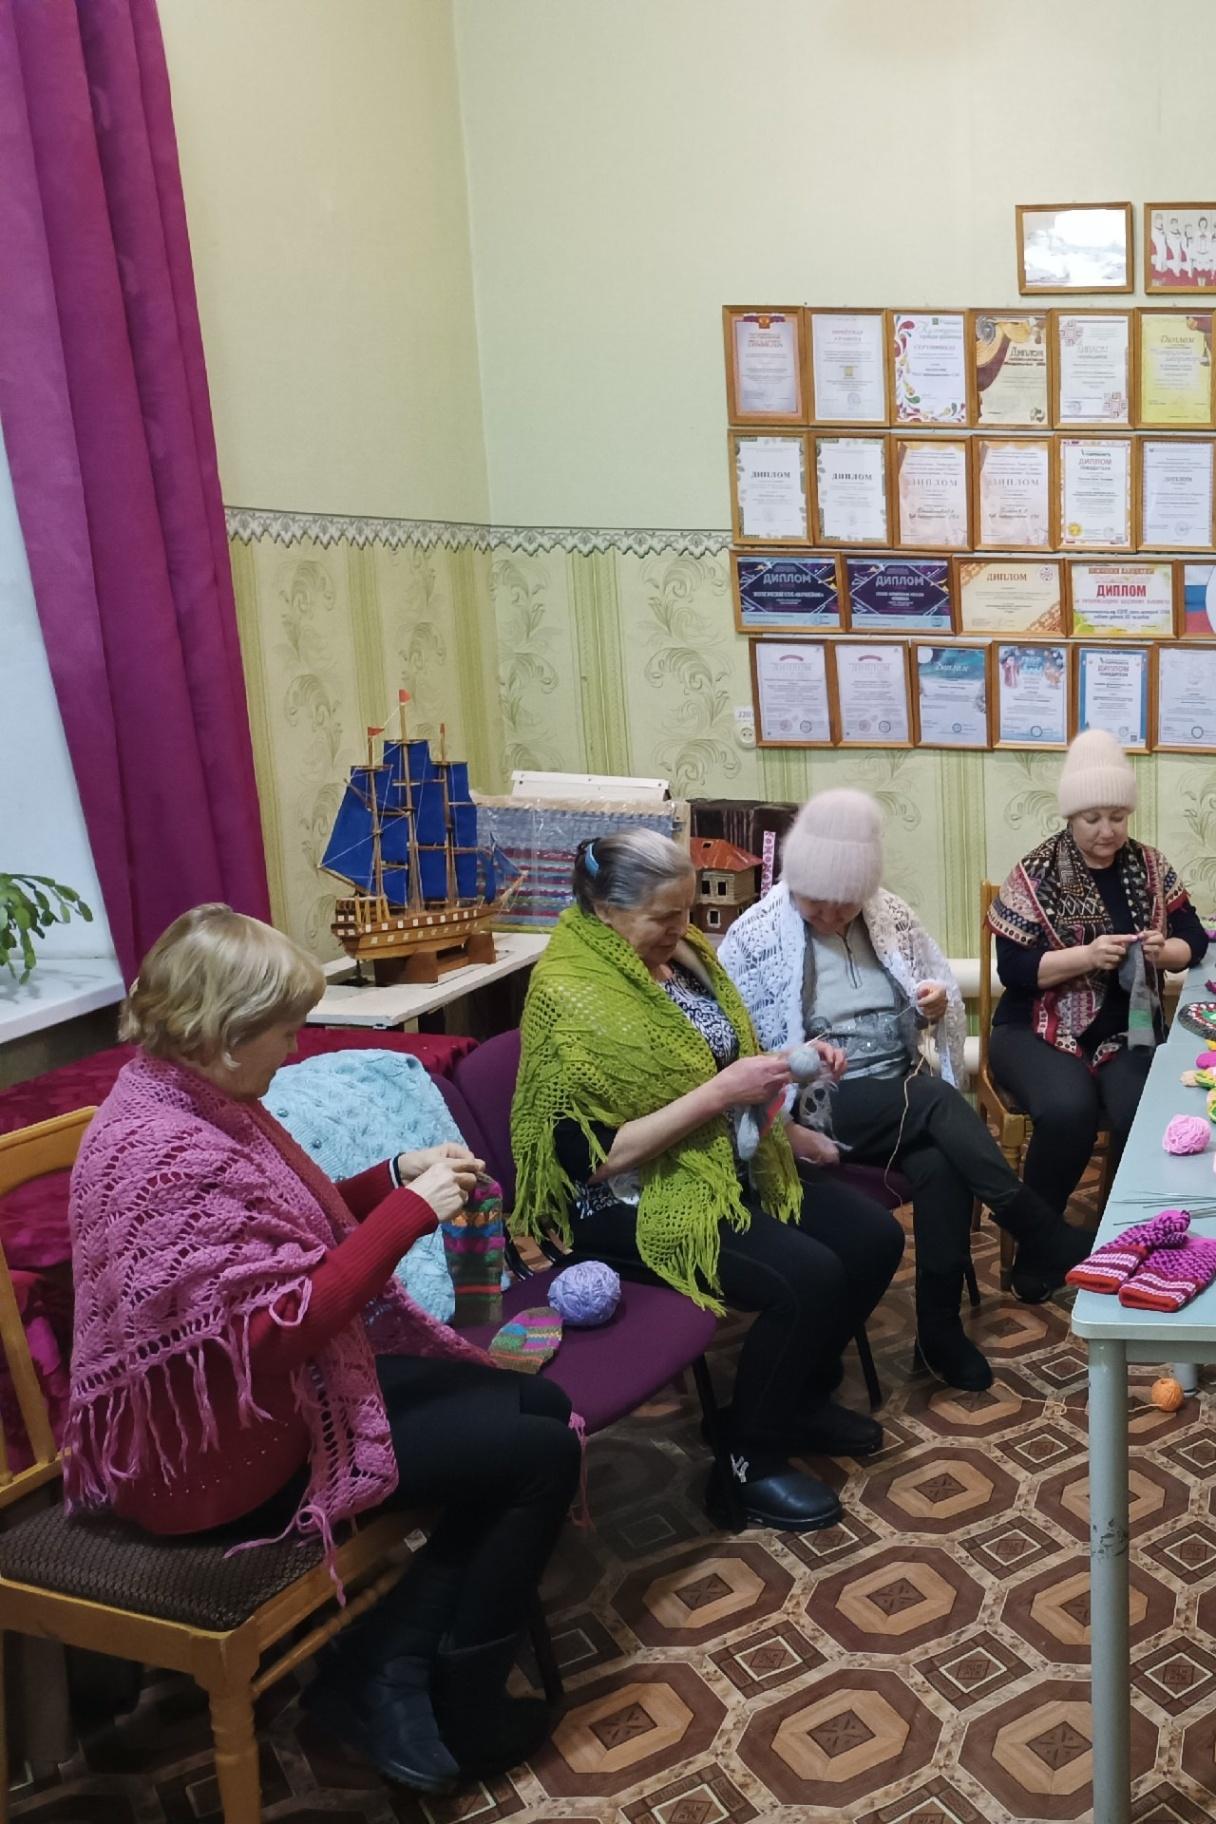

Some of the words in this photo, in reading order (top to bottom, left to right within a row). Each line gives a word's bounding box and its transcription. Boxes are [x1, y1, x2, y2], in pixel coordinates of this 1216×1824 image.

[751, 471, 791, 479] ДИПЛОМ
[763, 573, 812, 585] ДИПЛОМ
[875, 576, 925, 587] ДИПЛОМ
[986, 573, 1028, 582] ДИПЛОМ
[1096, 584, 1147, 598] ДИПЛОМ
